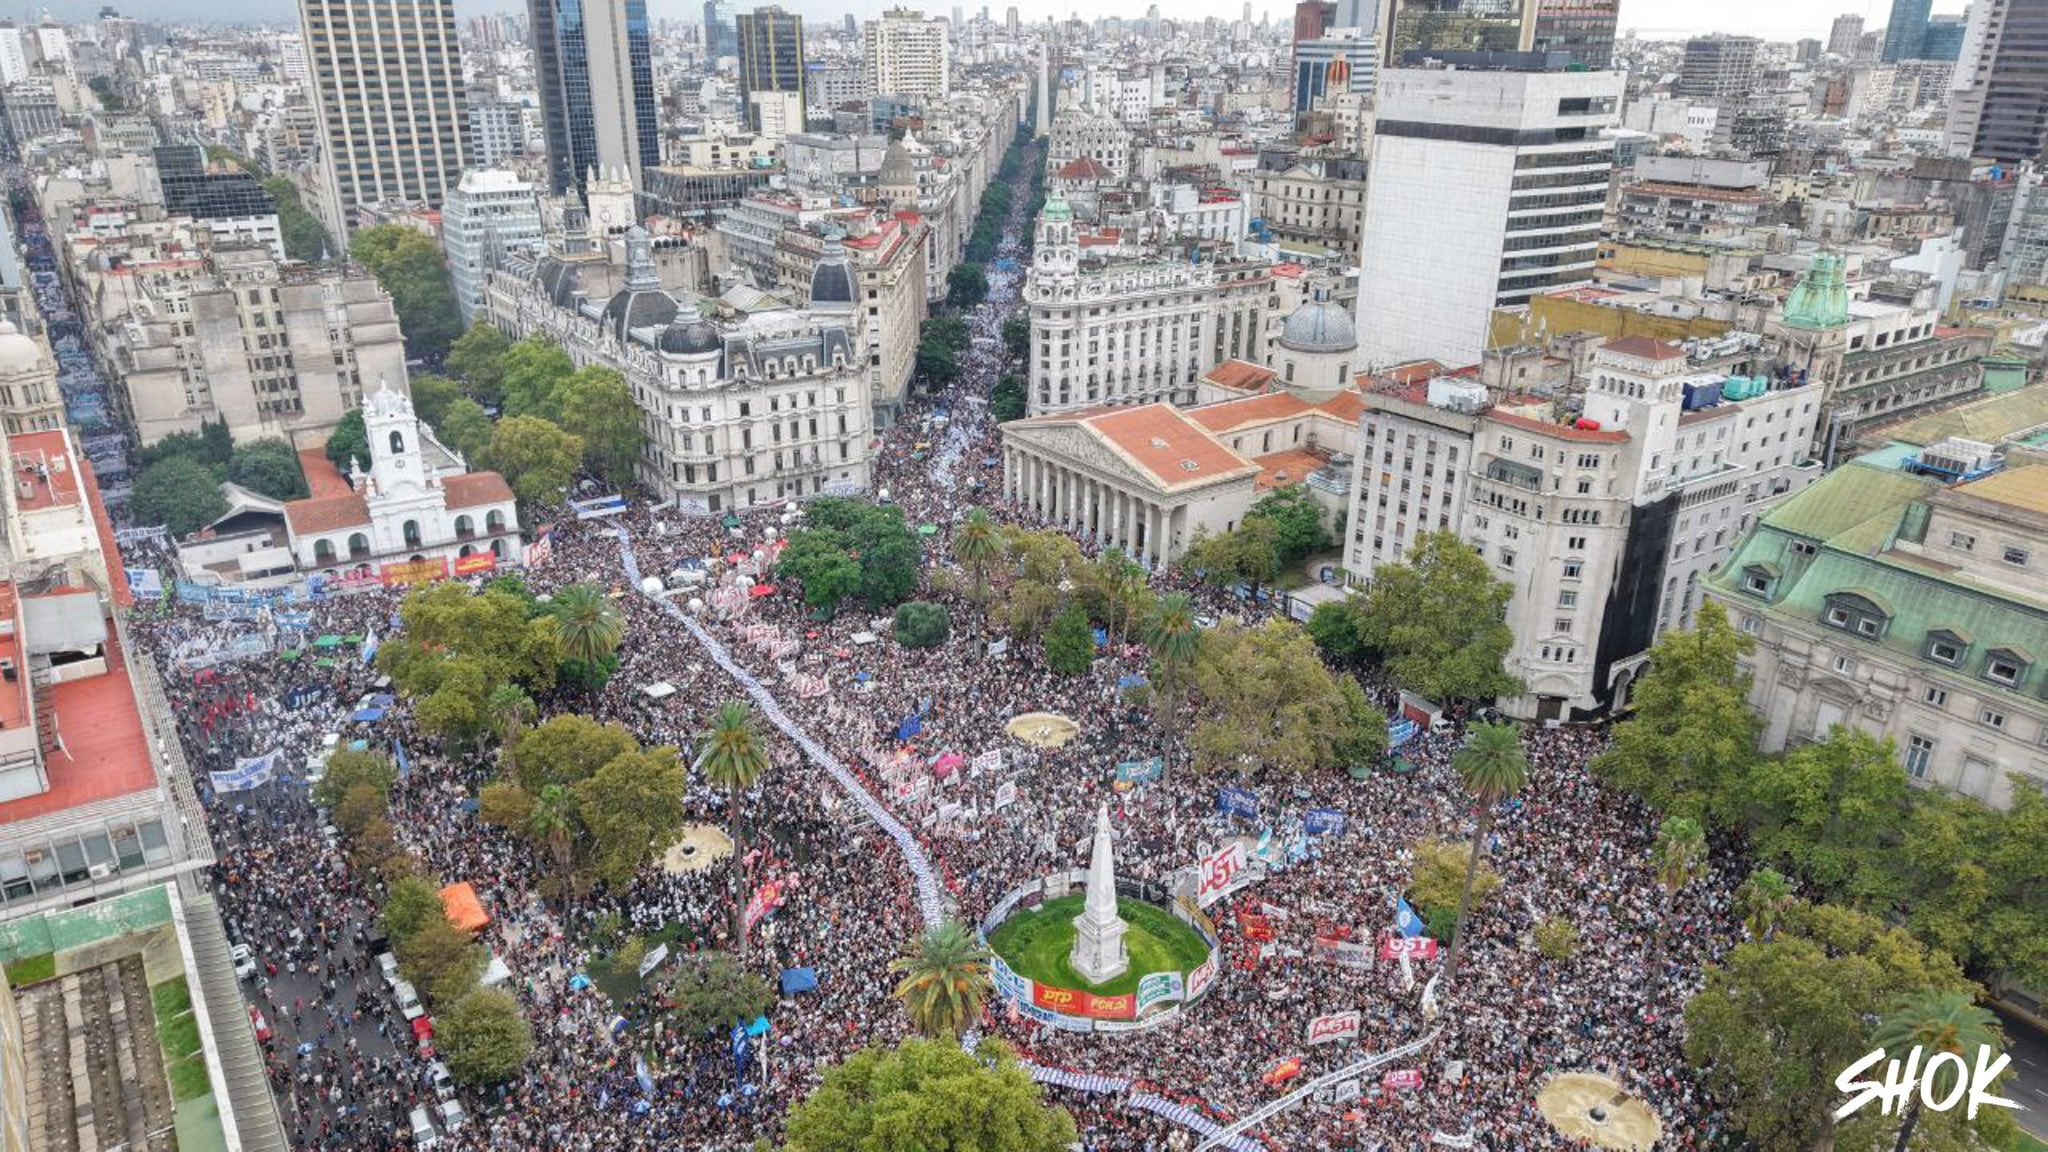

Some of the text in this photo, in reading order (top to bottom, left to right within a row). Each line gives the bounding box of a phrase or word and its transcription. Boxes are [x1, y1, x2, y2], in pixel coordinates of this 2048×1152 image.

[1200, 845, 1238, 895] MST
[1389, 938, 1431, 950] UST
[1044, 989, 1073, 1004] PTP
[1312, 1015, 1355, 1039] MST
